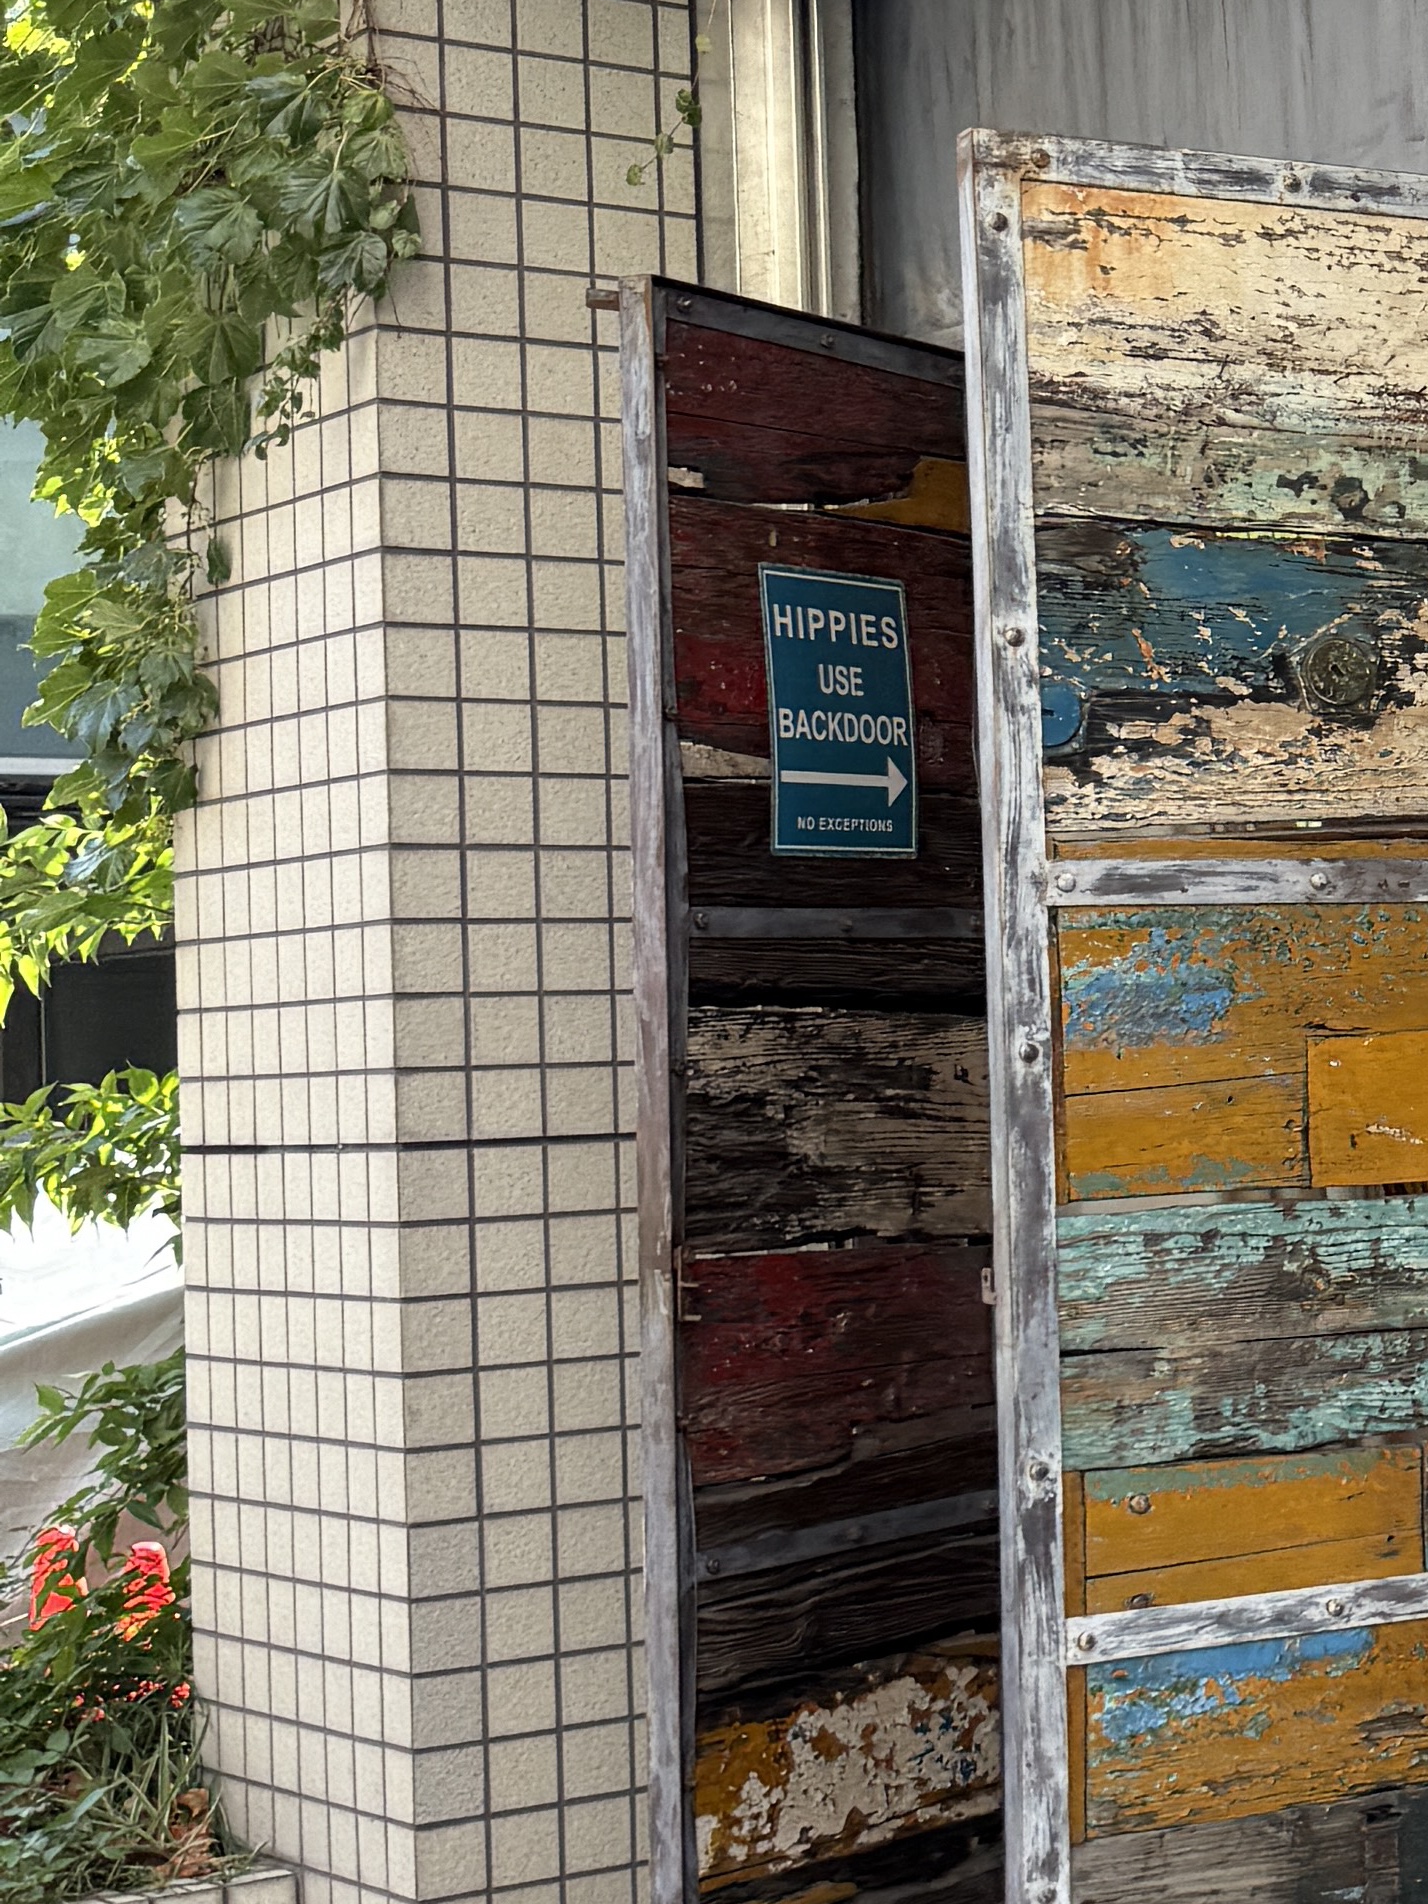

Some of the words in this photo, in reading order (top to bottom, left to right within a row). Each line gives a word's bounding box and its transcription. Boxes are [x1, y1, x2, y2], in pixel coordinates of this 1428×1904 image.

[773, 603, 899, 649] HIPPIES
[818, 663, 865, 697] USE
[778, 707, 908, 746] BACKDOOR
[797, 816, 816, 831] NO
[818, 817, 893, 833] EXCEPTIONS
